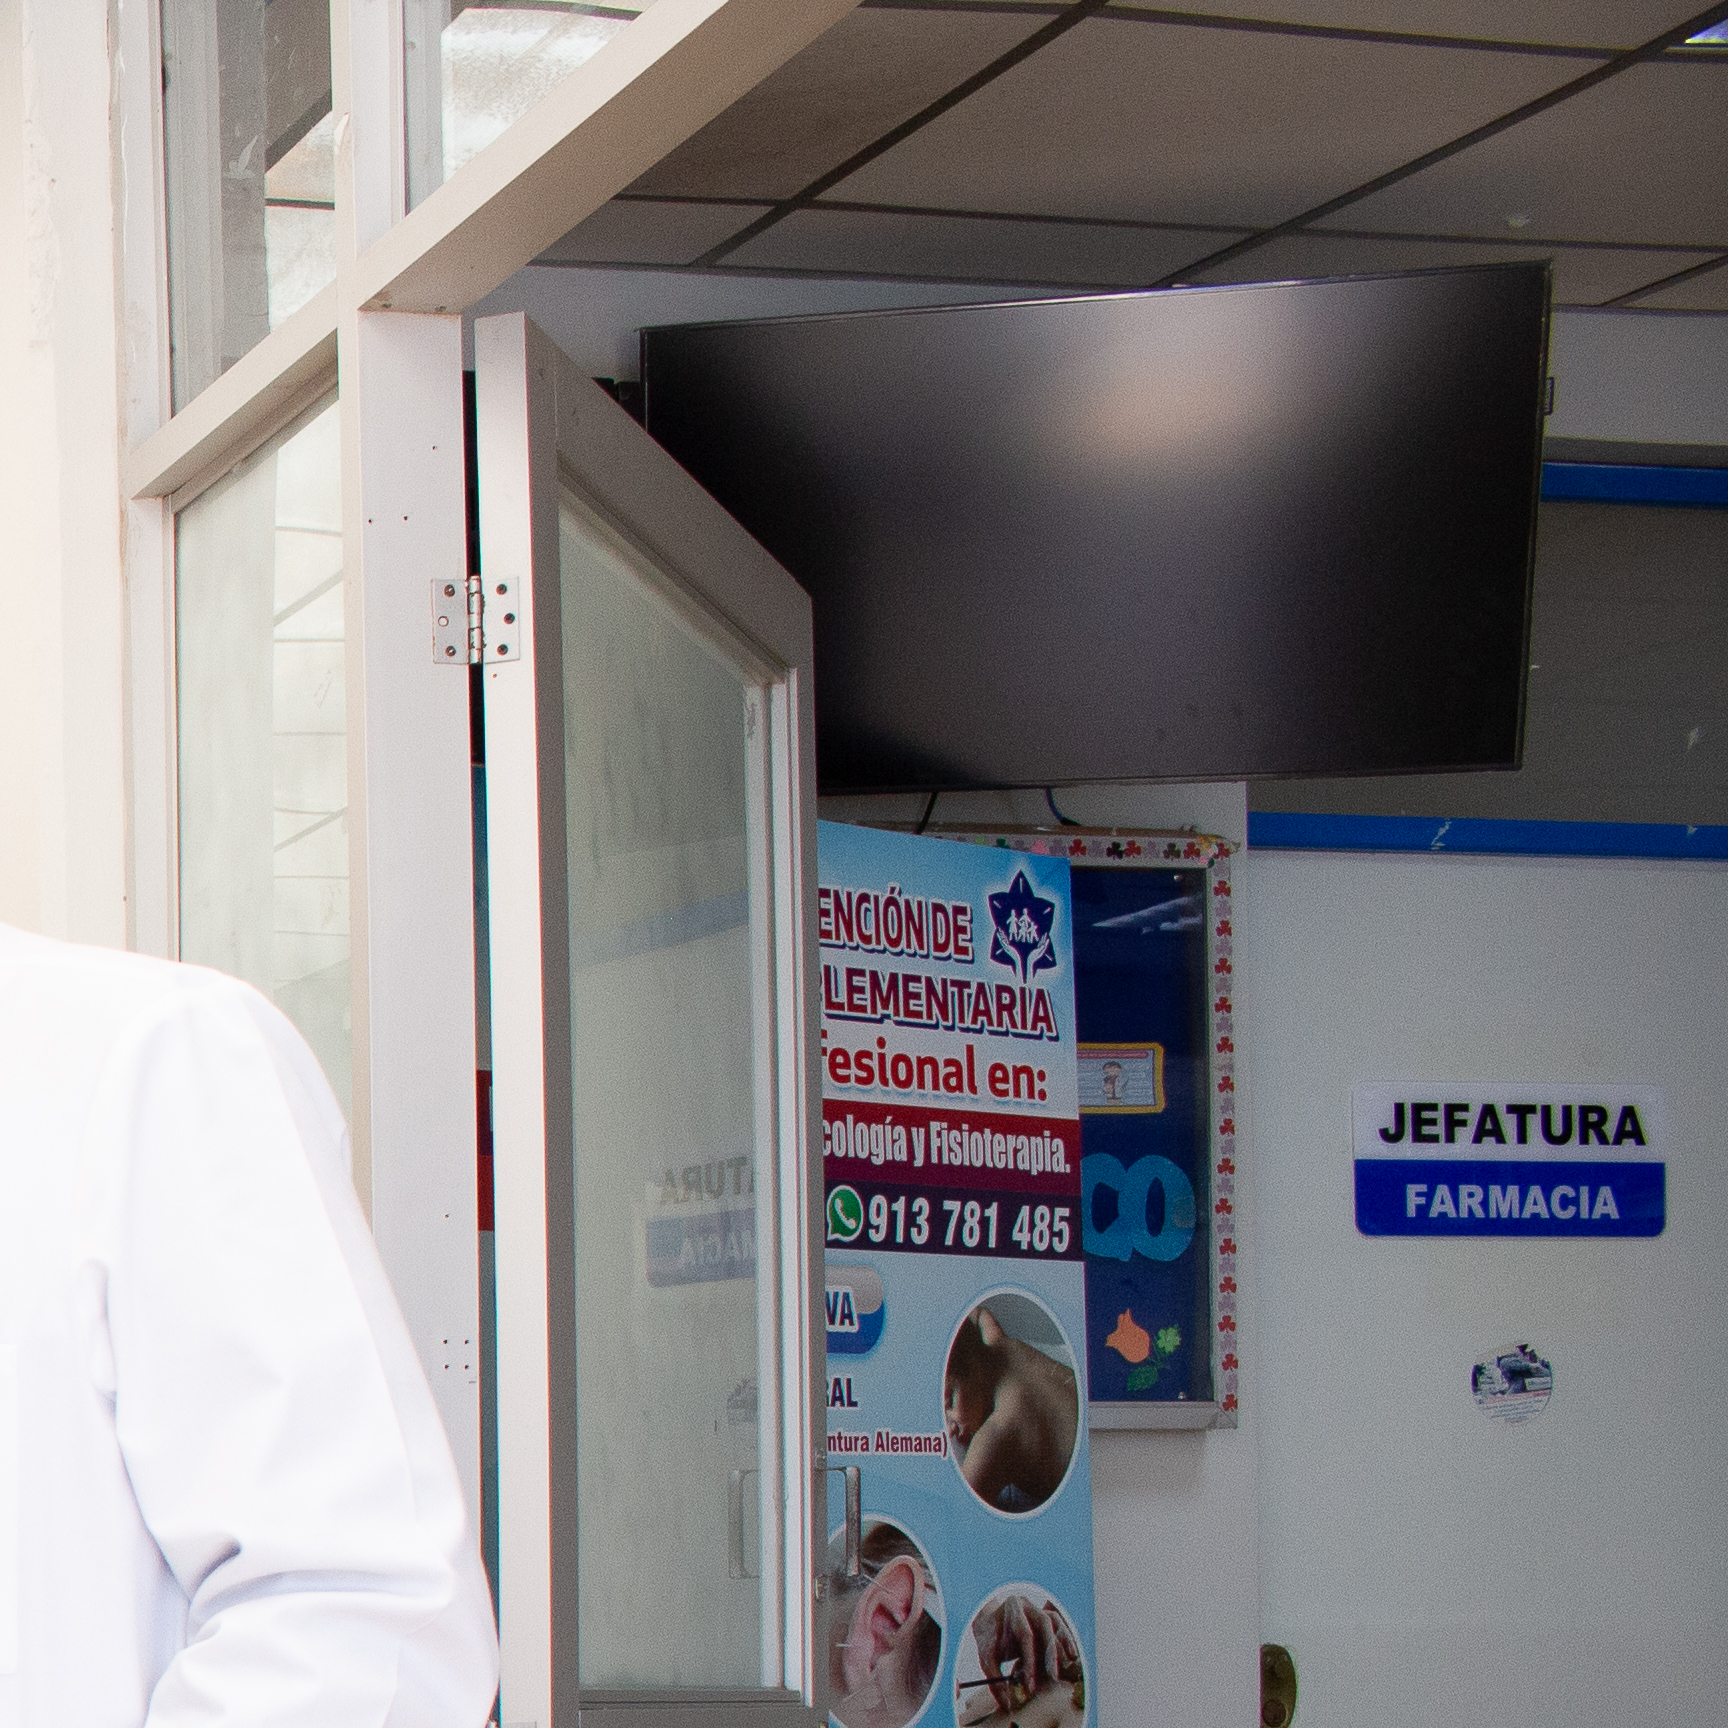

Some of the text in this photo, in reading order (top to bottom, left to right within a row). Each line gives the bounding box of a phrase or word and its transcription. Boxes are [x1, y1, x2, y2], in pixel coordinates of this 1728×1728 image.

[933, 901, 973, 960] DE
[819, 964, 1057, 1038] LEMENTARIA
[988, 1060, 1048, 1102] en:
[1378, 1101, 1647, 1147] JEFATURA
[911, 1129, 926, 1166] y
[929, 1120, 1072, 1176] Fisioterapia.
[867, 1194, 1071, 1253] 913 781 485
[1405, 1183, 1621, 1221] FARMACIA
[825, 1290, 855, 1327] VA
[827, 1431, 948, 1458] ntura Alemana)
